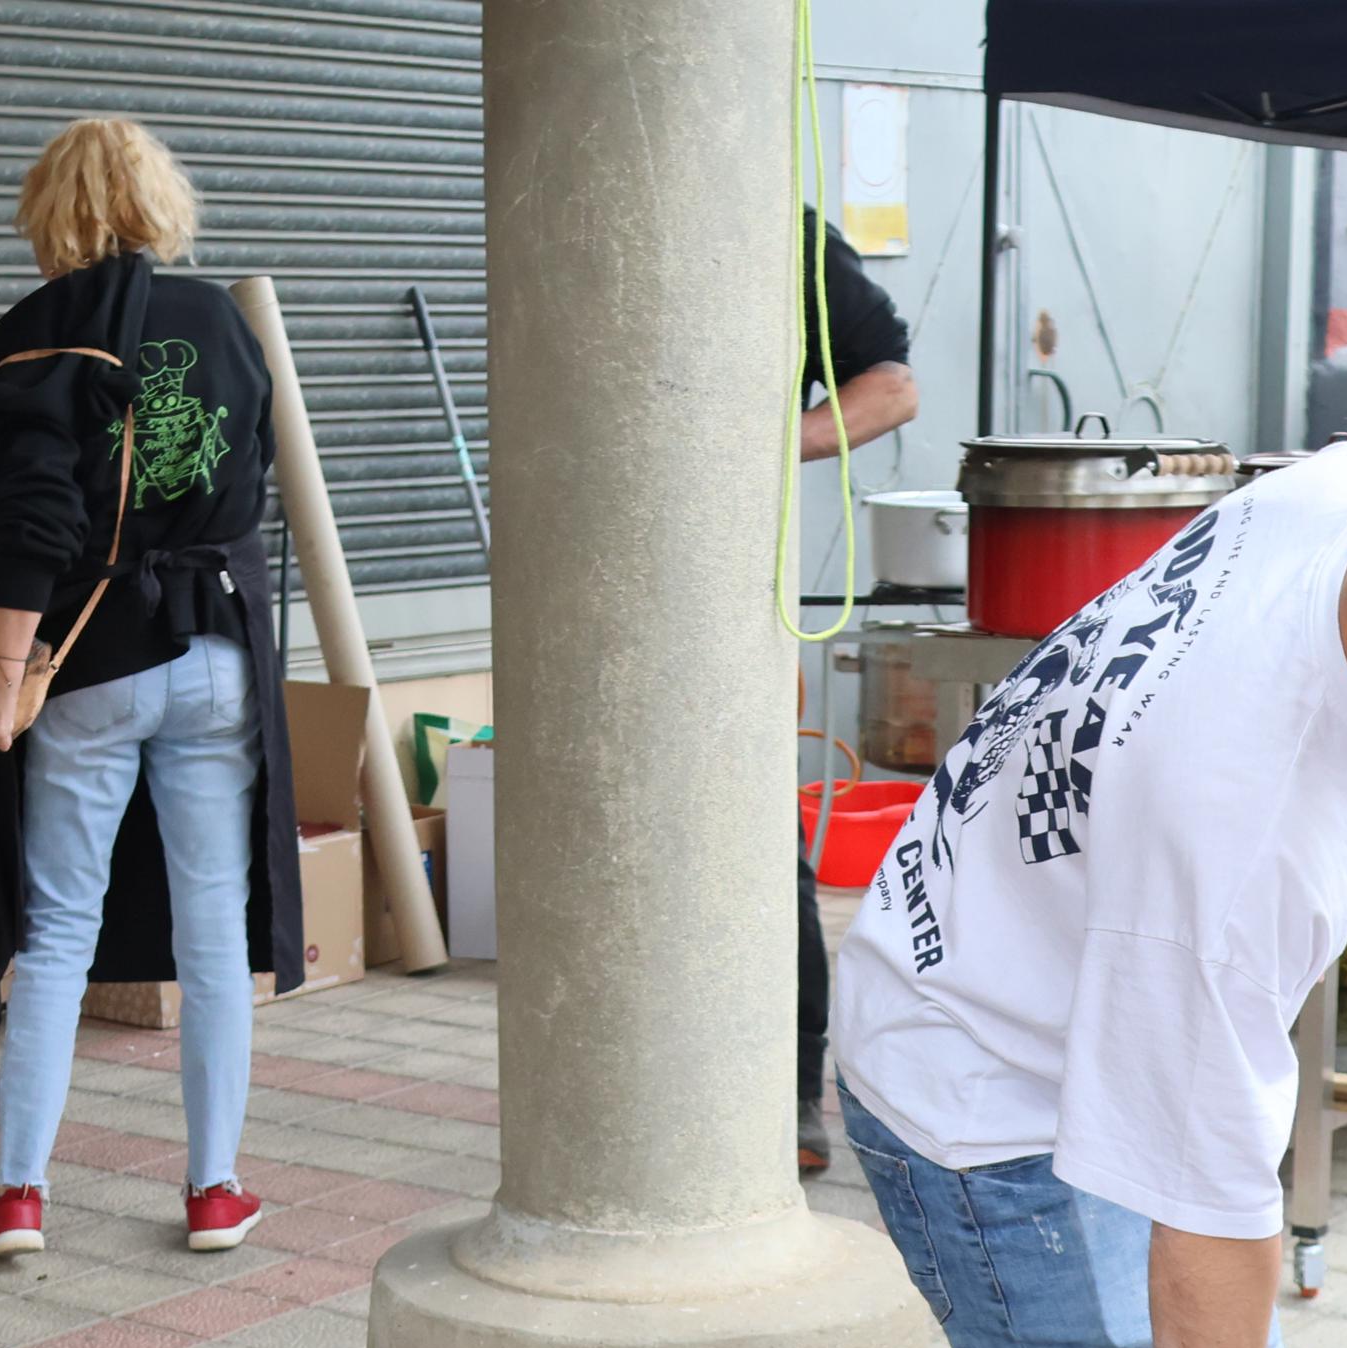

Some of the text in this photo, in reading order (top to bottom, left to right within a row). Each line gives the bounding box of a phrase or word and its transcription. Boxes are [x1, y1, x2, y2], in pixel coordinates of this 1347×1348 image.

[1228, 531, 1249, 562] LIFE
[1210, 568, 1232, 600] AND
[1157, 608, 1212, 682] LASTING
[1111, 693, 1156, 748] WEAR
[896, 839, 944, 974] CENTER
